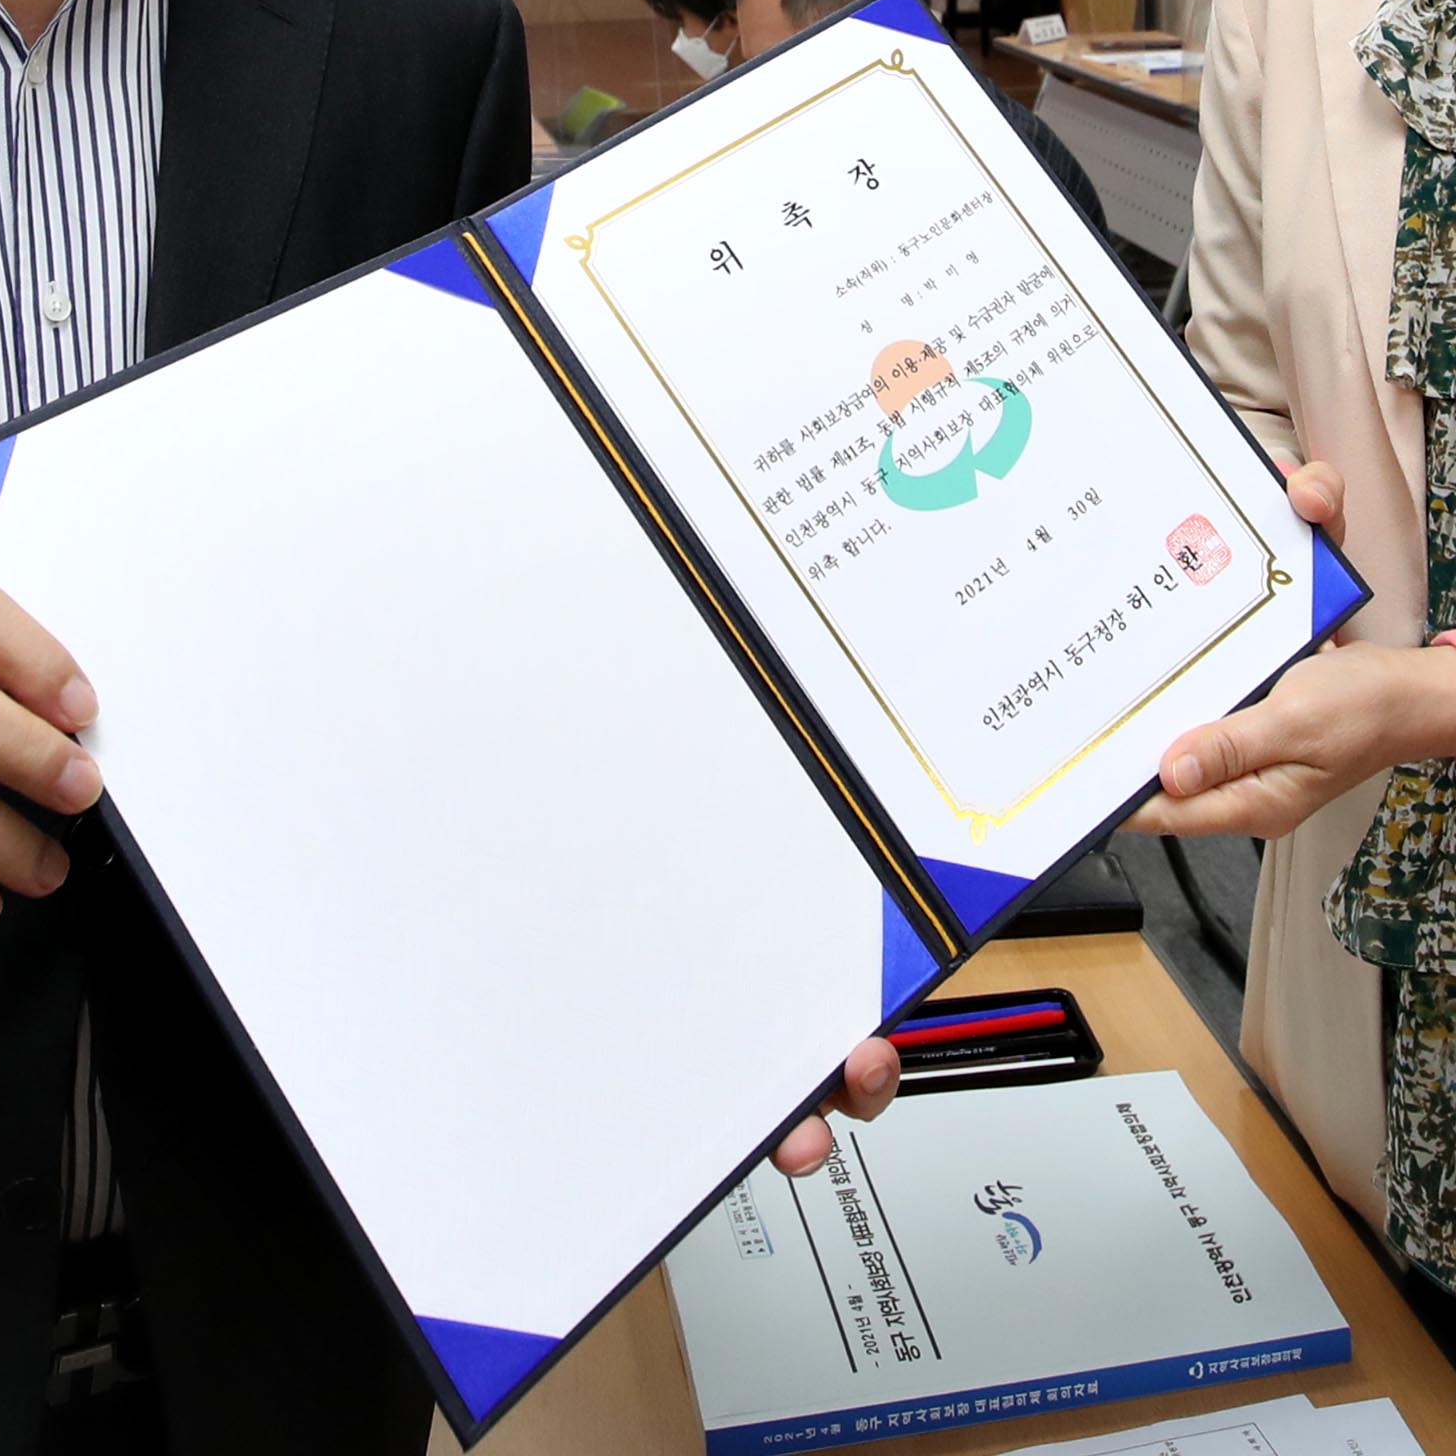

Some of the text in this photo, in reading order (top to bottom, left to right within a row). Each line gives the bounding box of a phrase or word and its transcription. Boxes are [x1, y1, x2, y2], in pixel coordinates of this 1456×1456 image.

[709, 158, 880, 275] 위 촉 장
[835, 258, 889, 298] 소속(직위)
[897, 191, 993, 257] 동구노인문화센터장
[753, 437, 797, 473] 귀하를
[799, 375, 891, 443] 사회보장급여의
[949, 324, 967, 344] 및
[1016, 264, 1055, 296] 발굴에
[762, 487, 794, 515] 관한
[795, 464, 827, 493] 법률
[876, 410, 907, 438] 동법
[909, 372, 961, 415] 시행규칙
[963, 340, 1008, 378] 제5조의
[1009, 312, 1050, 346] 규정에
[1049, 293, 1077, 318] 의거
[785, 324, 1100, 549] 인천광역시 동구 지역사회보장 대표협의체 위원으로
[808, 518, 892, 582] 위촉 합니다.
[954, 487, 1103, 606] 2021년 4월 30일
[982, 659, 1065, 732] 인천광역시
[1063, 608, 1128, 667] 동구청장
[1126, 585, 1153, 609] 허
[1153, 564, 1180, 592] 인
[835, 1187, 875, 1248] 대표협의체
[1115, 1103, 1253, 1304] 인천광역시 동구 지역사회보장협의체
[847, 1295, 864, 1312] 4월
[854, 1316, 881, 1356] 2021년
[859, 1251, 905, 1327] 지역사회보장
[890, 1331, 921, 1362] 동구
[763, 1427, 816, 1444] 2021년
[855, 1416, 883, 1433] 동구
[888, 1402, 970, 1428] 지역사회보장
[974, 1390, 1042, 1413] 대표협의체
[1046, 1379, 1099, 1402] 회의자료
